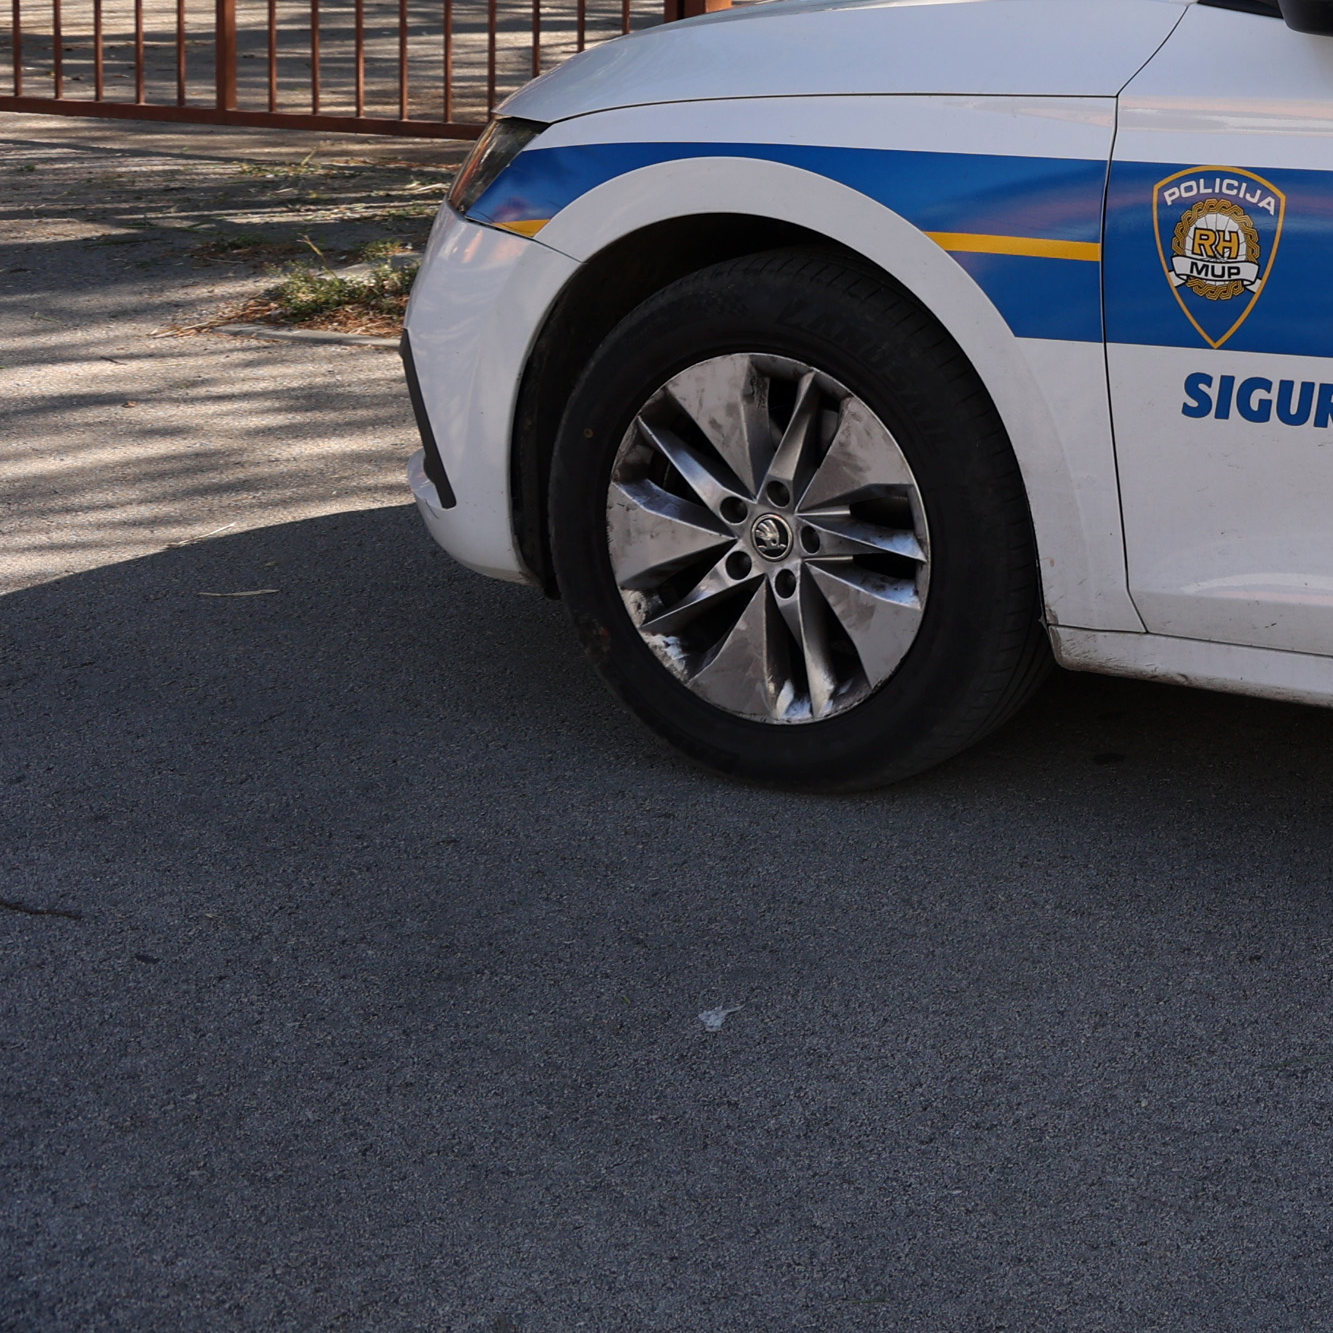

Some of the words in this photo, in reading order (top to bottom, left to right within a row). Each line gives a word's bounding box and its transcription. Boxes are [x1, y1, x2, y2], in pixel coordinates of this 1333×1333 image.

[1164, 179, 1275, 215] POLICIJA
[1193, 228, 1239, 259] RH
[1190, 262, 1240, 278] MUP
